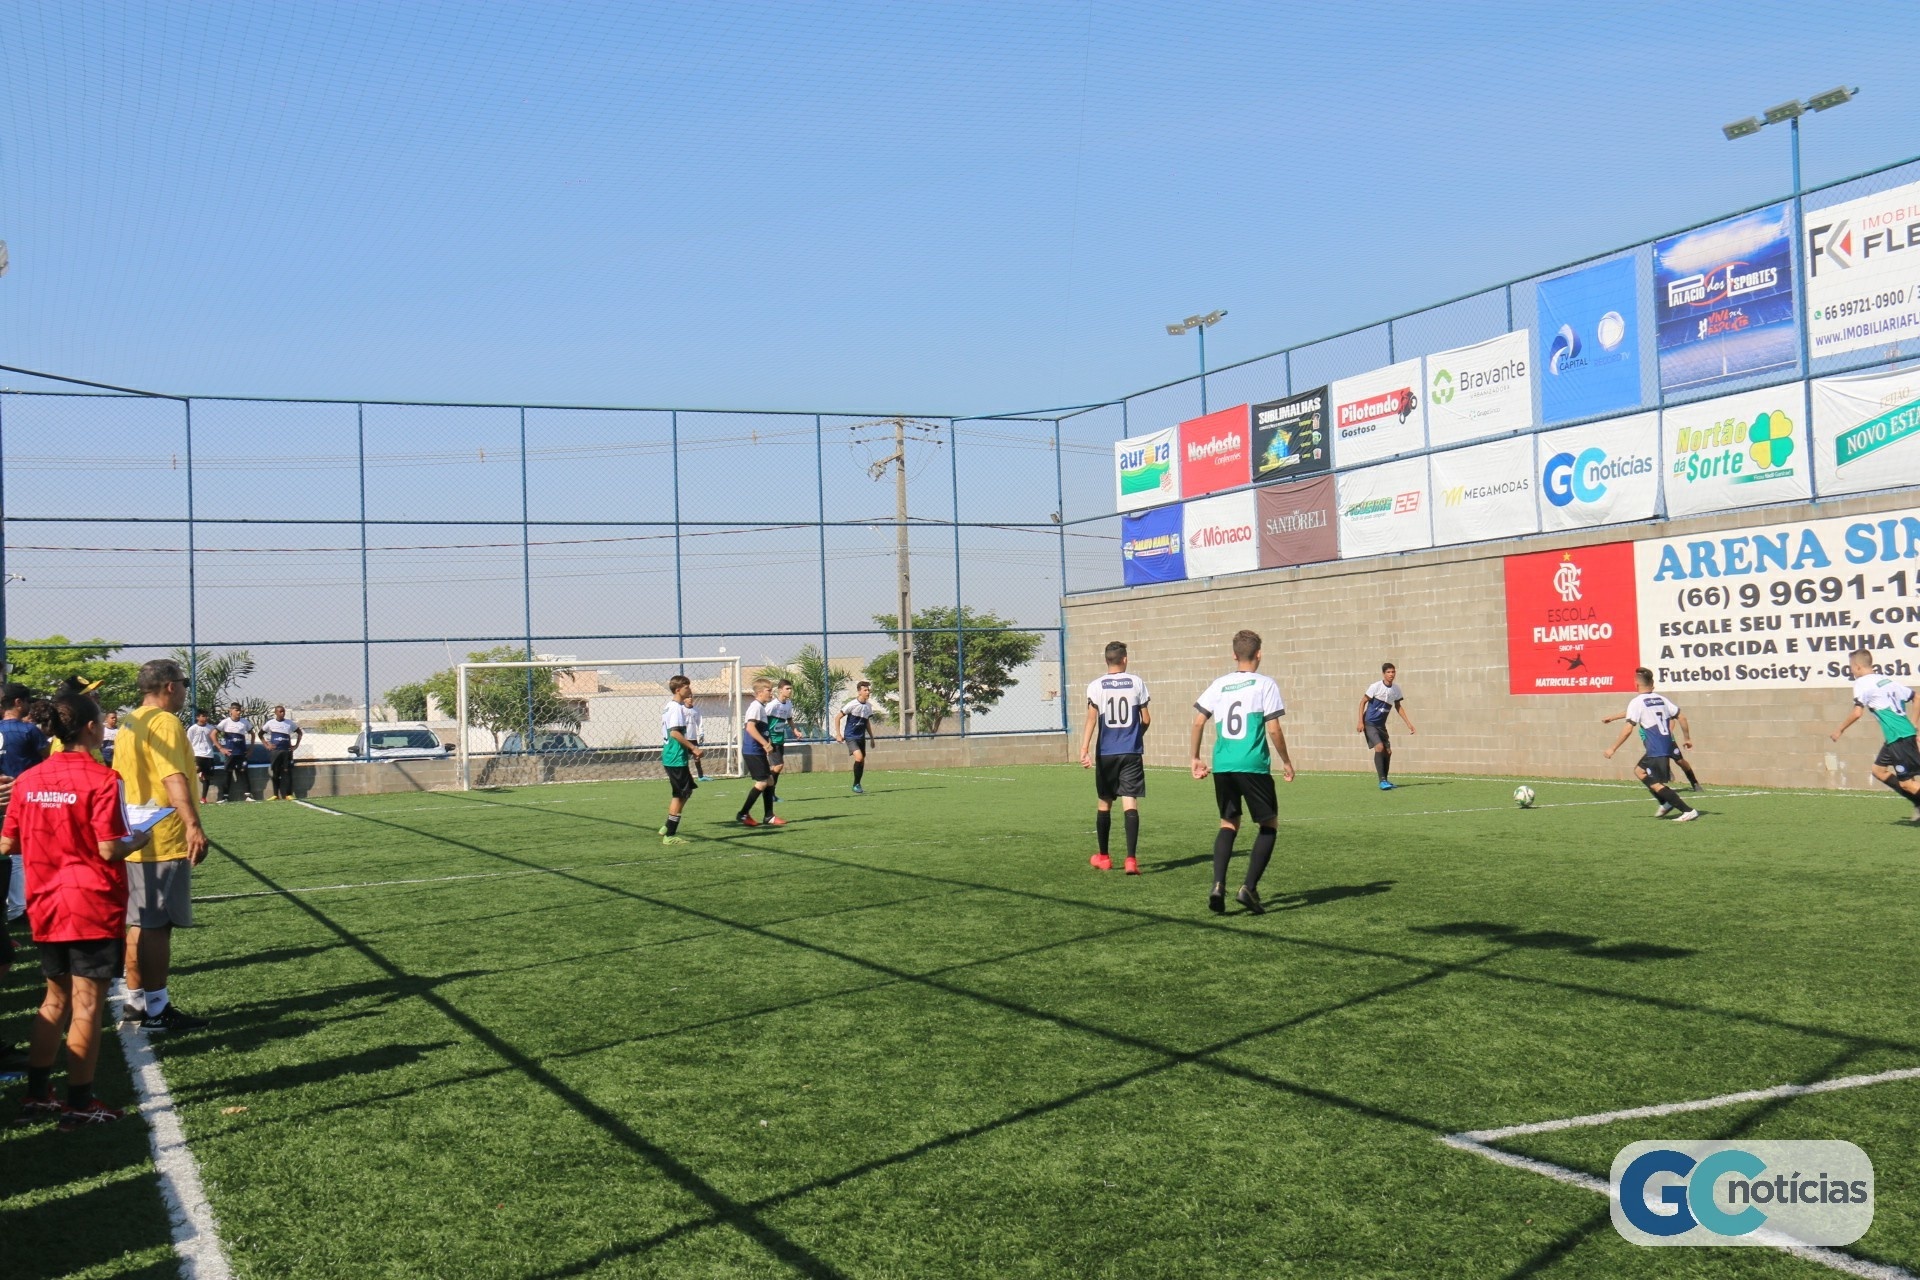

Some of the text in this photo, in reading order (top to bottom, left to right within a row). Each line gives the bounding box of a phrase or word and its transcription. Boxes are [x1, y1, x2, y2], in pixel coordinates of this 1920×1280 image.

[1707, 276, 1725, 292] dos
[1824, 305, 1838, 320] 66
[1839, 290, 1904, 317] 99721-0900
[1816, 312, 1920, 346] www.IMOBILIARIAFL
[1460, 360, 1525, 391] Bravante
[1560, 359, 1588, 371] CAPITAL
[1258, 397, 1321, 425] SUBLIMALHAS
[1341, 396, 1399, 424] Pilotando
[1341, 424, 1376, 438] Gostoso
[1676, 418, 1747, 454] Nortão
[1847, 422, 1886, 455] NOVO
[1590, 456, 1653, 481] notícias
[1464, 478, 1529, 500] MEGAMODAS
[1203, 526, 1252, 547] Mônaco
[1653, 528, 1832, 581] ARENA
[1677, 569, 1920, 612] (66) 9 9691-1
[1548, 607, 1597, 622] ESCOLA
[1659, 618, 1732, 637] ESCALE
[1739, 615, 1782, 632] SEU
[1790, 610, 1861, 629] TIME,
[1533, 623, 1612, 643] FLAMENGO
[1660, 645, 1675, 660] A
[1680, 639, 1778, 659] TORCIDA
[1786, 638, 1799, 653] E
[1806, 633, 1895, 653] VENHA
[1535, 677, 1588, 688] MATRICULE-SE
[1658, 665, 1731, 683] Futebol
[1735, 662, 1811, 682] Society
[1827, 659, 1911, 681] Sqash
[1107, 696, 1129, 725] 10
[1226, 701, 1242, 736] 6
[1655, 712, 1667, 733] 7
[26, 792, 77, 805] FLAMENGO
